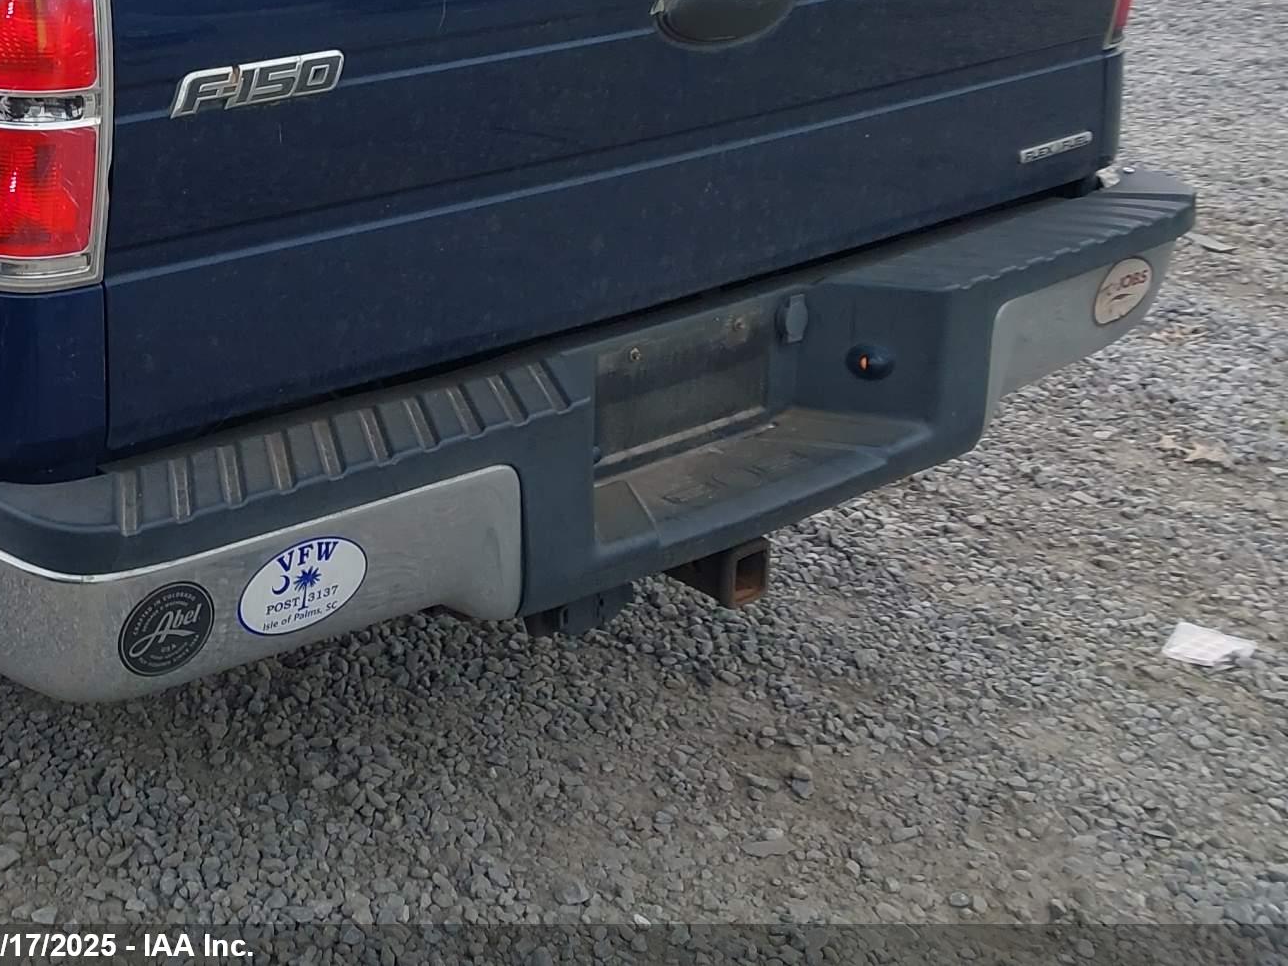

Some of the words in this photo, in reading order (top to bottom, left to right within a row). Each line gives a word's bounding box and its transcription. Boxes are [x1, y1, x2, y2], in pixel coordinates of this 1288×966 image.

[170, 49, 345, 119] F-150
[277, 541, 339, 572] VFW
[266, 597, 300, 615] POST
[308, 585, 339, 602] 3137
[129, 603, 202, 658] Abel
[262, 621, 278, 631] Isle
[281, 615, 291, 625] of
[293, 607, 322, 621] Palms,
[325, 601, 338, 611] SC
